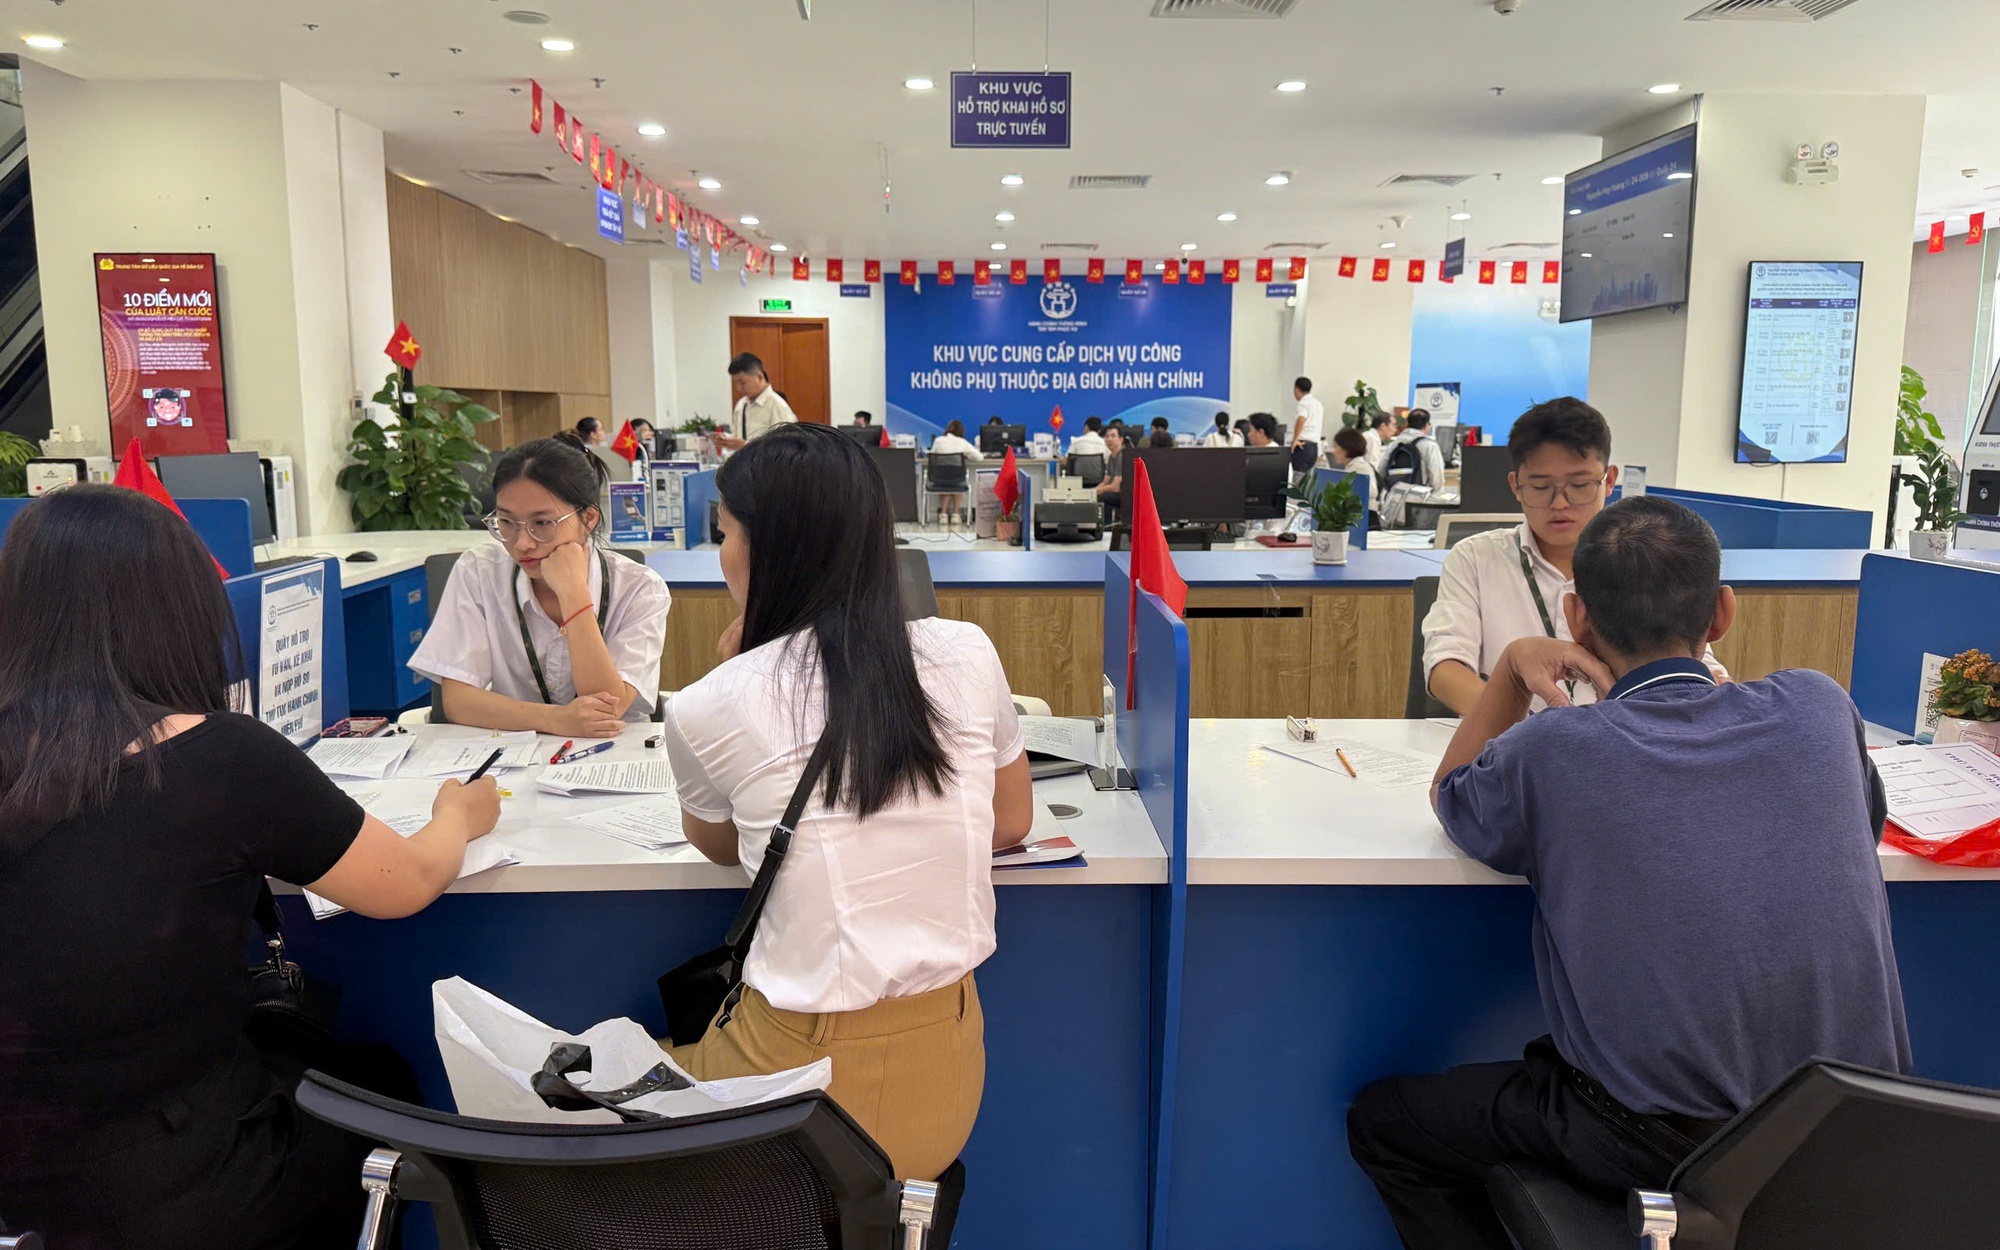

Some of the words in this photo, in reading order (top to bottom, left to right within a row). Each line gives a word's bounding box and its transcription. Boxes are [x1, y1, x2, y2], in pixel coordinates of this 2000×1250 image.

[979, 82, 1009, 95] KHU
[1013, 81, 1042, 97] VỰC
[957, 95, 975, 114] HỖ
[976, 100, 1000, 116] TRỢ
[1002, 101, 1028, 114] KHAI
[1031, 96, 1048, 114] HỒ
[1049, 100, 1066, 114] SƠ
[976, 121, 1007, 138] TRỰC
[1009, 117, 1046, 136] TUYẾN
[123, 293, 141, 307] 10
[143, 287, 181, 307] ĐIỂM
[182, 289, 212, 307] MỚI
[125, 307, 144, 316] CỦA
[144, 307, 166, 317] LUẬT
[168, 307, 187, 316] CĂN
[188, 307, 213, 316] CƯỚC
[933, 345, 964, 363] KHU
[968, 343, 998, 366] VỰC
[1001, 345, 1043, 363] CUNG
[1046, 340, 1075, 363] CẤP
[1078, 345, 1114, 366] DỊCH
[1117, 345, 1138, 366] VỤ
[1140, 341, 1181, 363] CÔNG
[910, 369, 962, 389] KHÔNG
[966, 372, 996, 392] PHỤ
[1000, 369, 1049, 393] THUỘC
[1052, 372, 1077, 392] ĐỊA
[1080, 368, 1110, 389] GIỚI
[1113, 369, 1154, 389] HÀNH
[1157, 367, 1203, 389] CHÍNH
